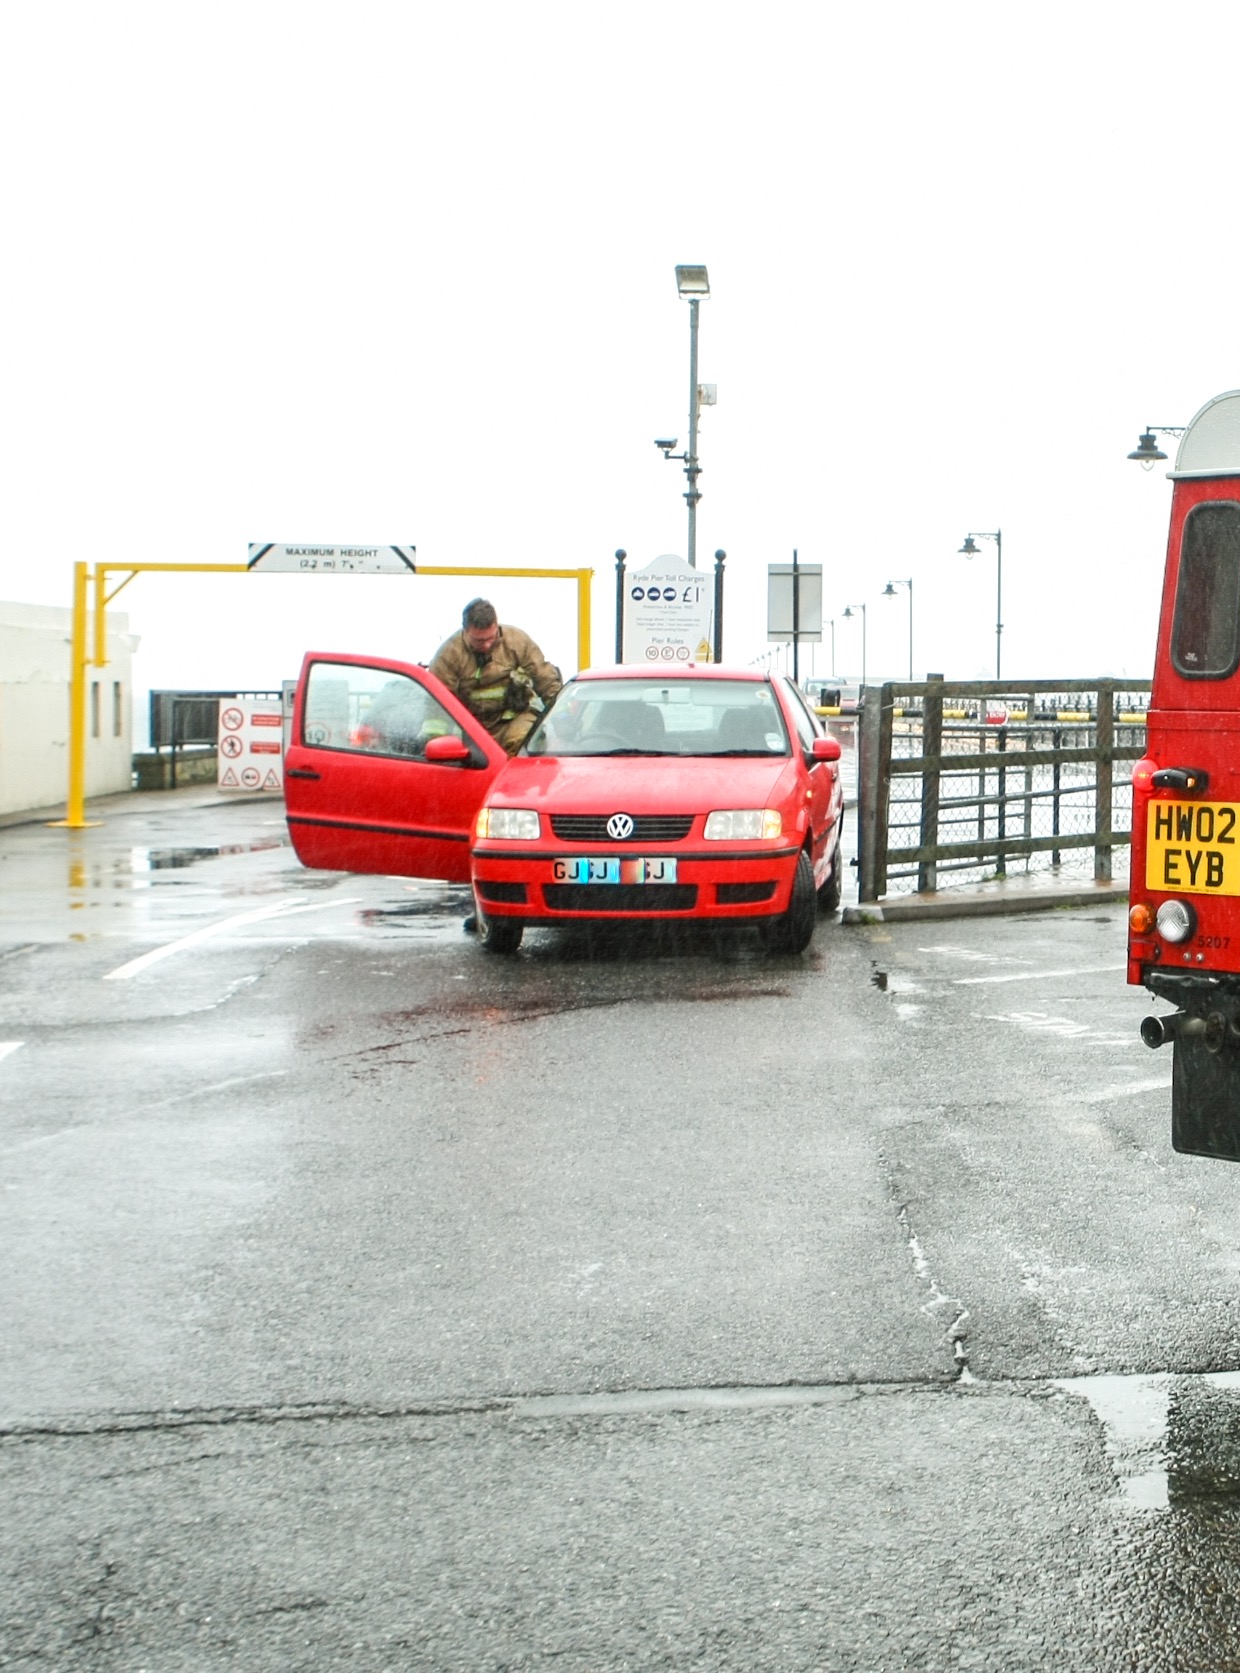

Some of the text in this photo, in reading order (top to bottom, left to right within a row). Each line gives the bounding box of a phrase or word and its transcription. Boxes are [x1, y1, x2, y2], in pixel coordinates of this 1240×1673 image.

[286, 547, 378, 557] MAXIMUM HEIGHT
[633, 574, 704, 583] Ryde Pier Toll Charges
[667, 637, 684, 645] Rules
[1154, 804, 1236, 844] HW02
[1164, 848, 1225, 888] EYB
[1197, 935, 1231, 949] 5207
